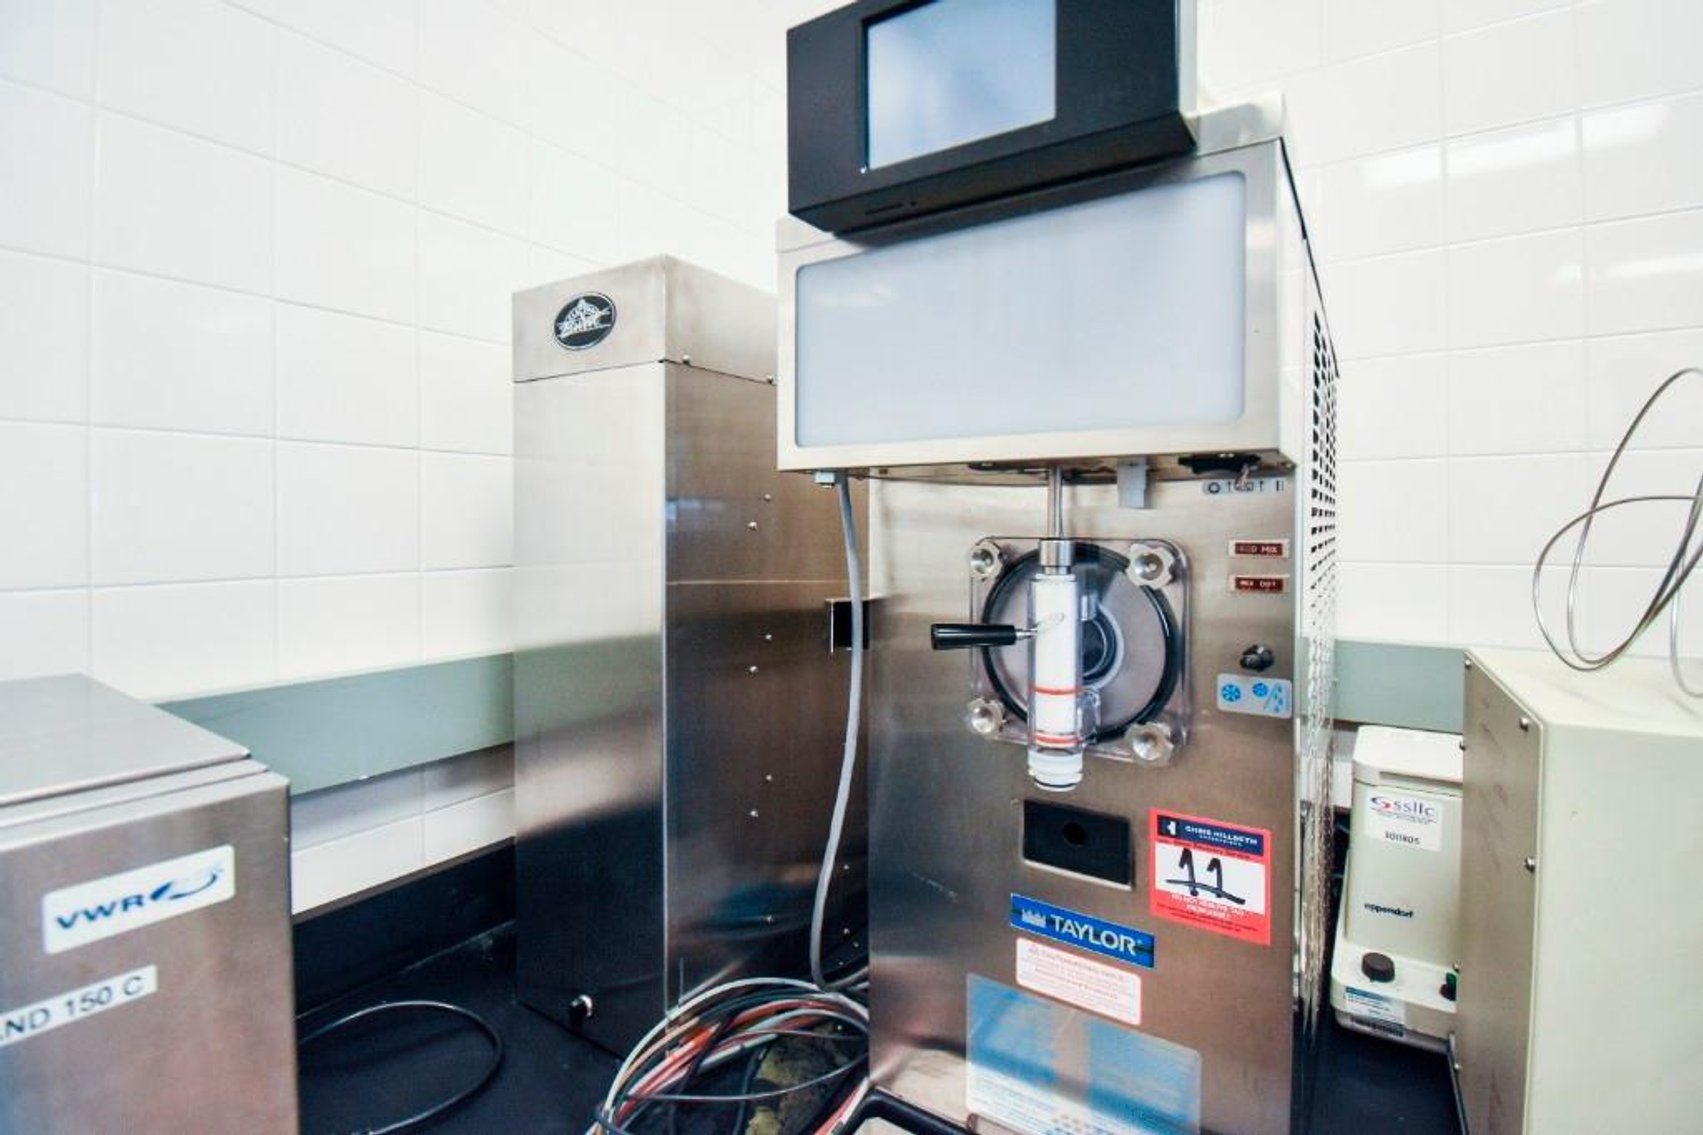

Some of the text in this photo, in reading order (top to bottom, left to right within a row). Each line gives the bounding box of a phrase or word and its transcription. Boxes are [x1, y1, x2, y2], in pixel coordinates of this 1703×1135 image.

[56, 894, 145, 930] VWR
[1364, 902, 1414, 918] eppendorf
[1049, 913, 1137, 956] TAYLOR
[0, 975, 143, 1040] ND 150 C
